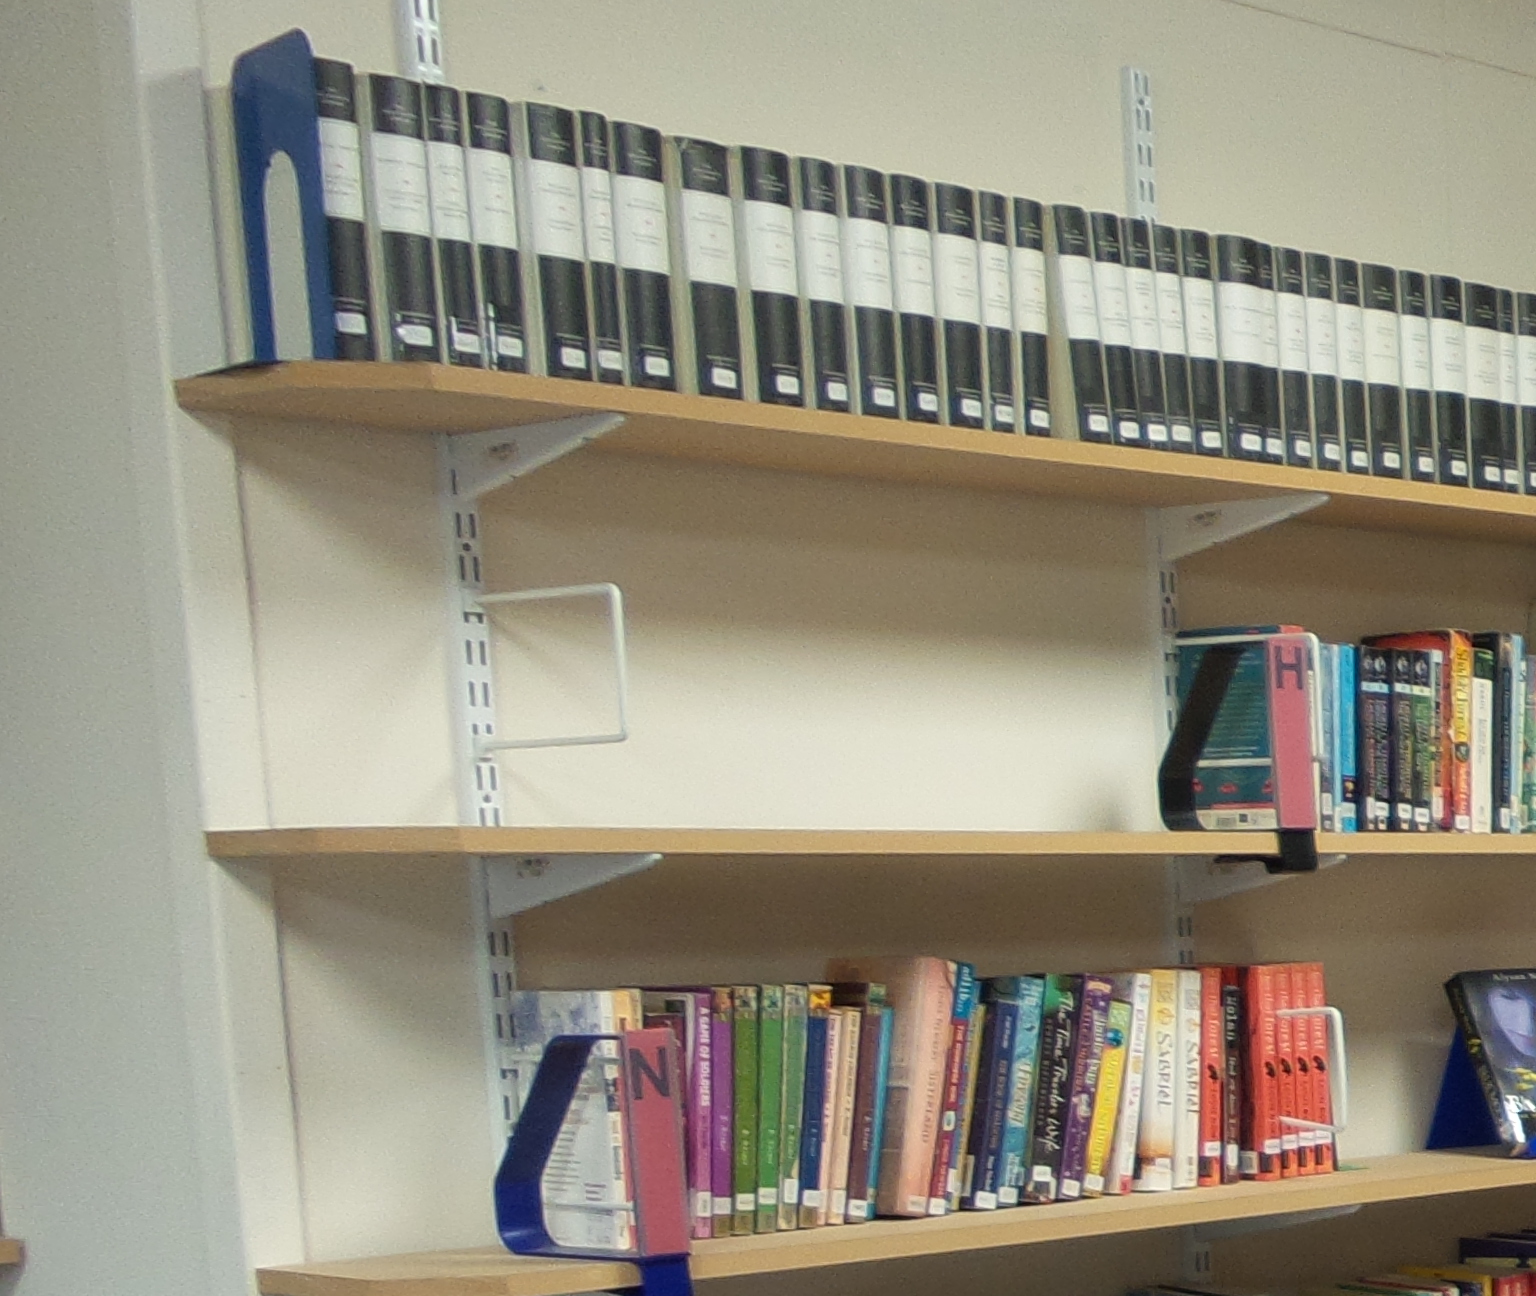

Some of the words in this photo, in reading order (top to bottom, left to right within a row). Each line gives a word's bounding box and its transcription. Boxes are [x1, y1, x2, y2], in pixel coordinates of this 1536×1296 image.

[1274, 645, 1304, 692] H
[628, 1045, 672, 1100] N
[1157, 1030, 1173, 1108] SABRIEL
[1185, 1038, 1200, 1115] SABRIEL
